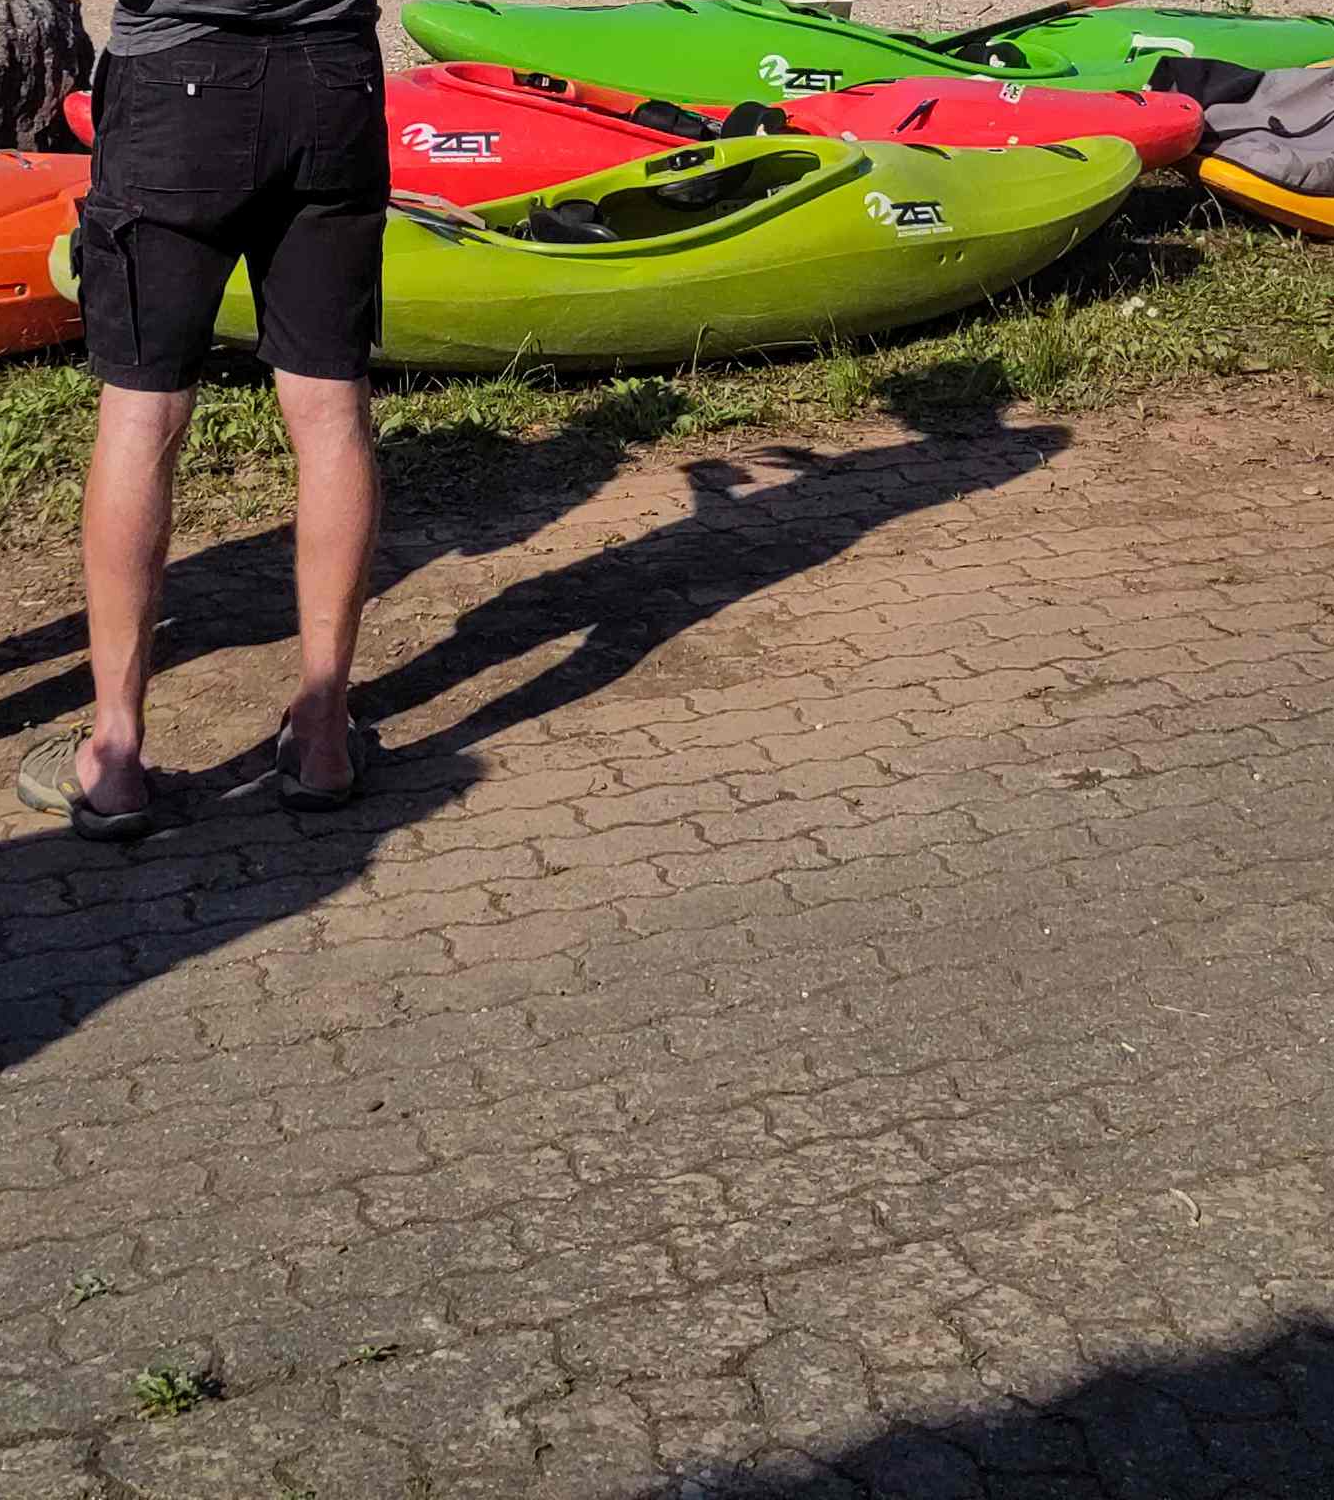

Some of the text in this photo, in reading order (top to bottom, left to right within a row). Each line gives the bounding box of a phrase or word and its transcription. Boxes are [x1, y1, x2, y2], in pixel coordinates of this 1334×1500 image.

[784, 68, 844, 92] ZET
[430, 131, 501, 156] ZET
[890, 201, 947, 227] ZET
